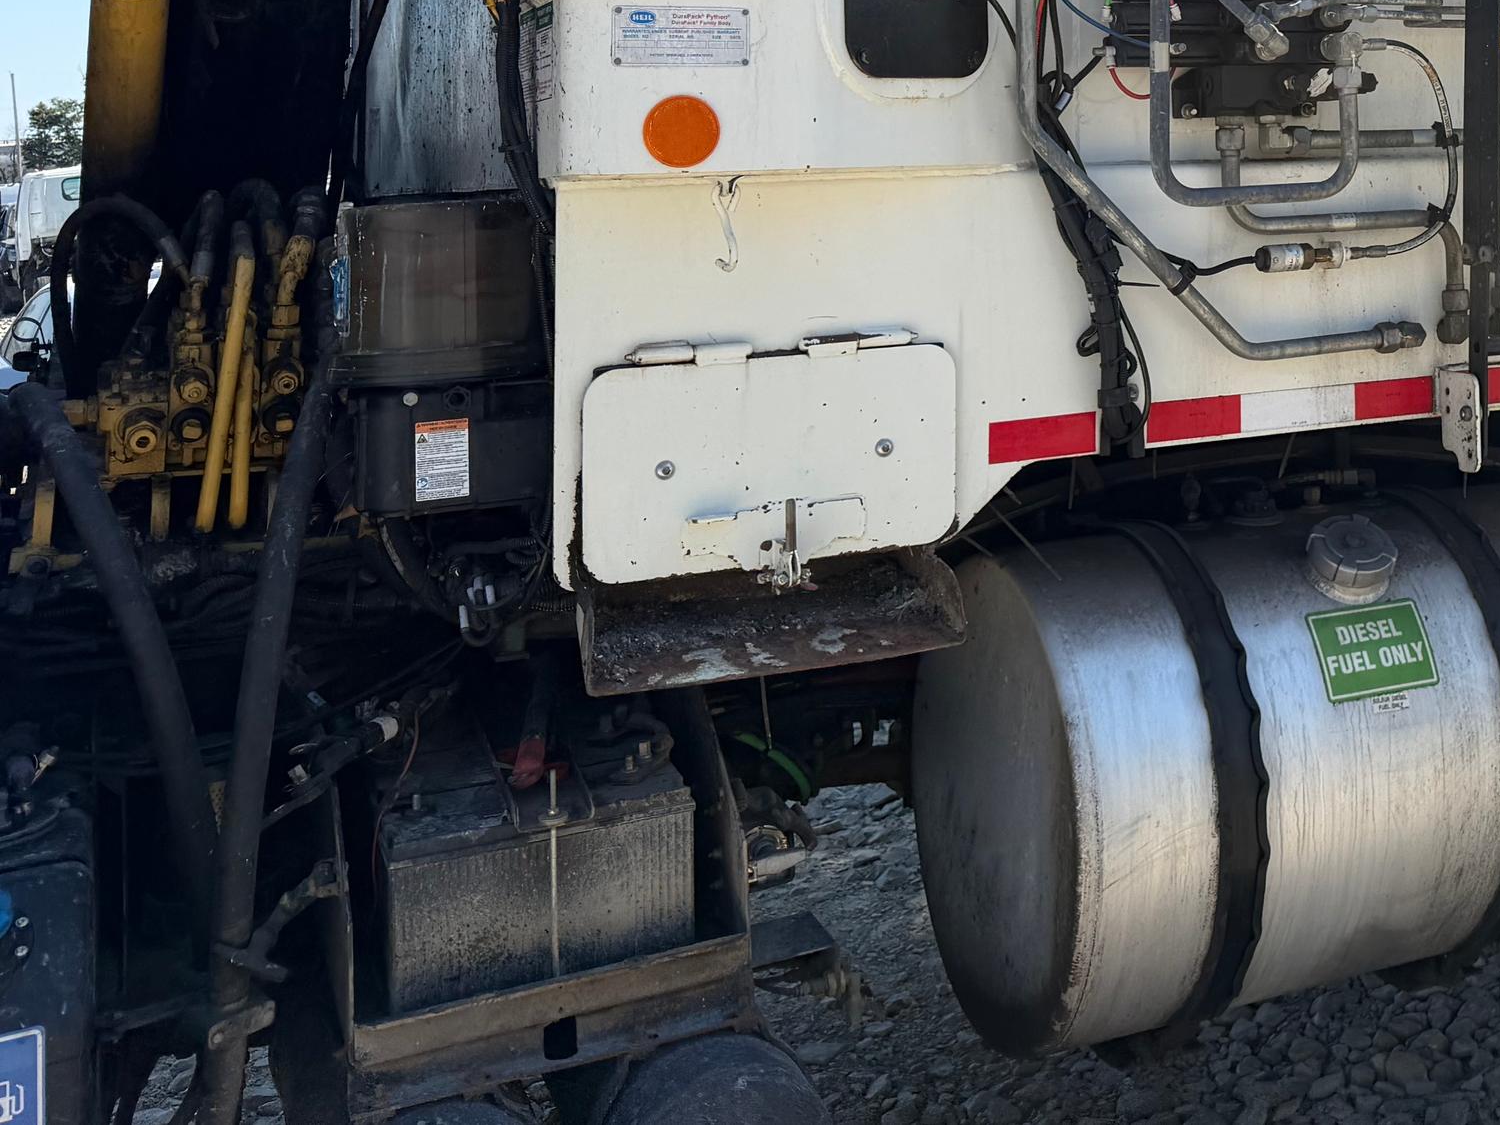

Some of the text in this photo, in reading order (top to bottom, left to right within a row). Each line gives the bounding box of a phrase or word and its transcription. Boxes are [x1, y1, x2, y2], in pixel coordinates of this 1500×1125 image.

[1335, 618, 1402, 646] DIESEL
[1326, 641, 1424, 677] FUEL ONLY
